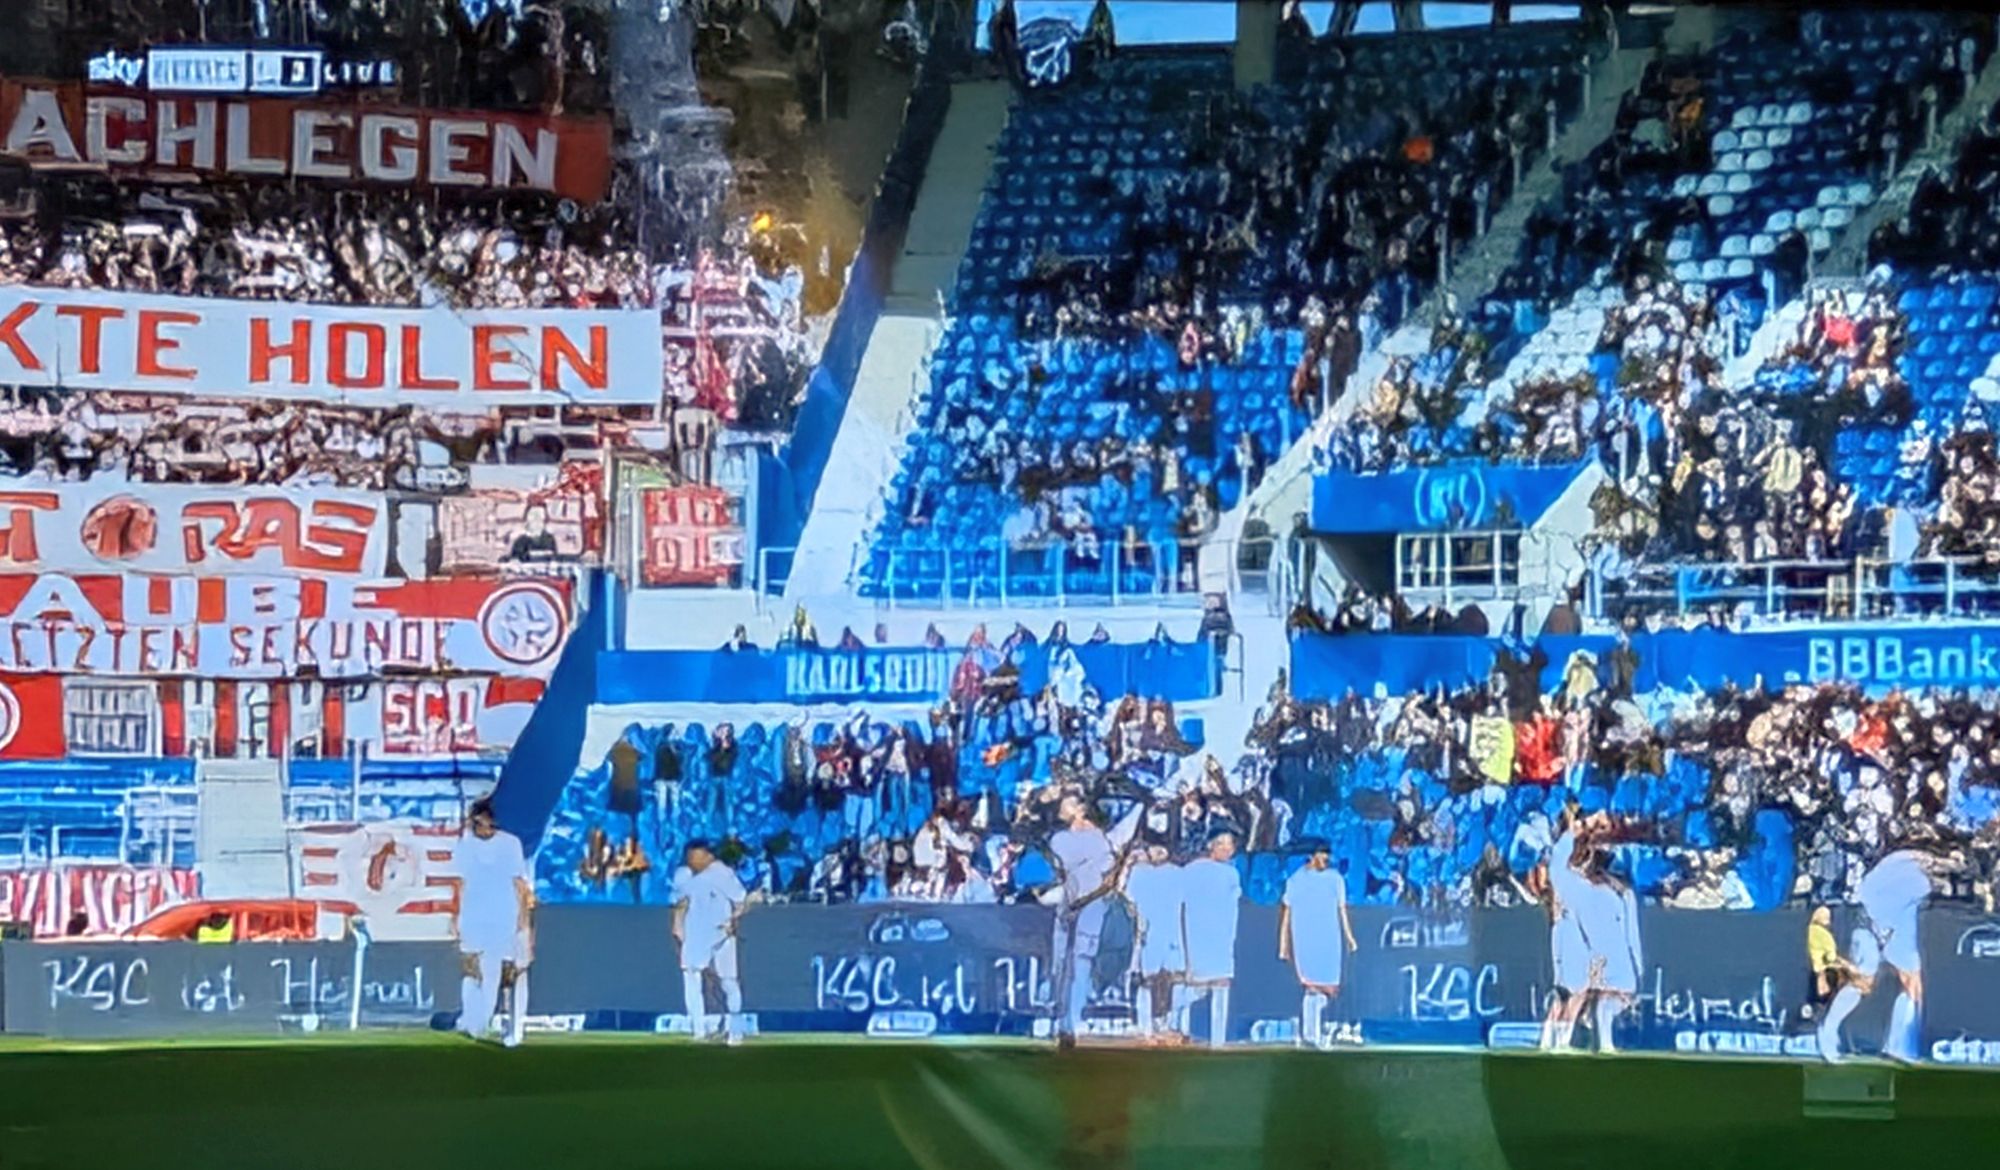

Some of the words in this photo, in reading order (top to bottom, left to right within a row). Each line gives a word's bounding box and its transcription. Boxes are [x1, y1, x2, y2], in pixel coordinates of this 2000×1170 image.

[88, 51, 143, 85] sky
[5, 88, 558, 192] ACHLEGEN
[249, 317, 608, 391] HOLEN
[786, 653, 955, 696] KARLSRUH
[1808, 633, 2000, 683] BBBank
[44, 956, 150, 1011] KSC
[811, 956, 900, 1013] KSC
[1399, 963, 1505, 1021] KSC
